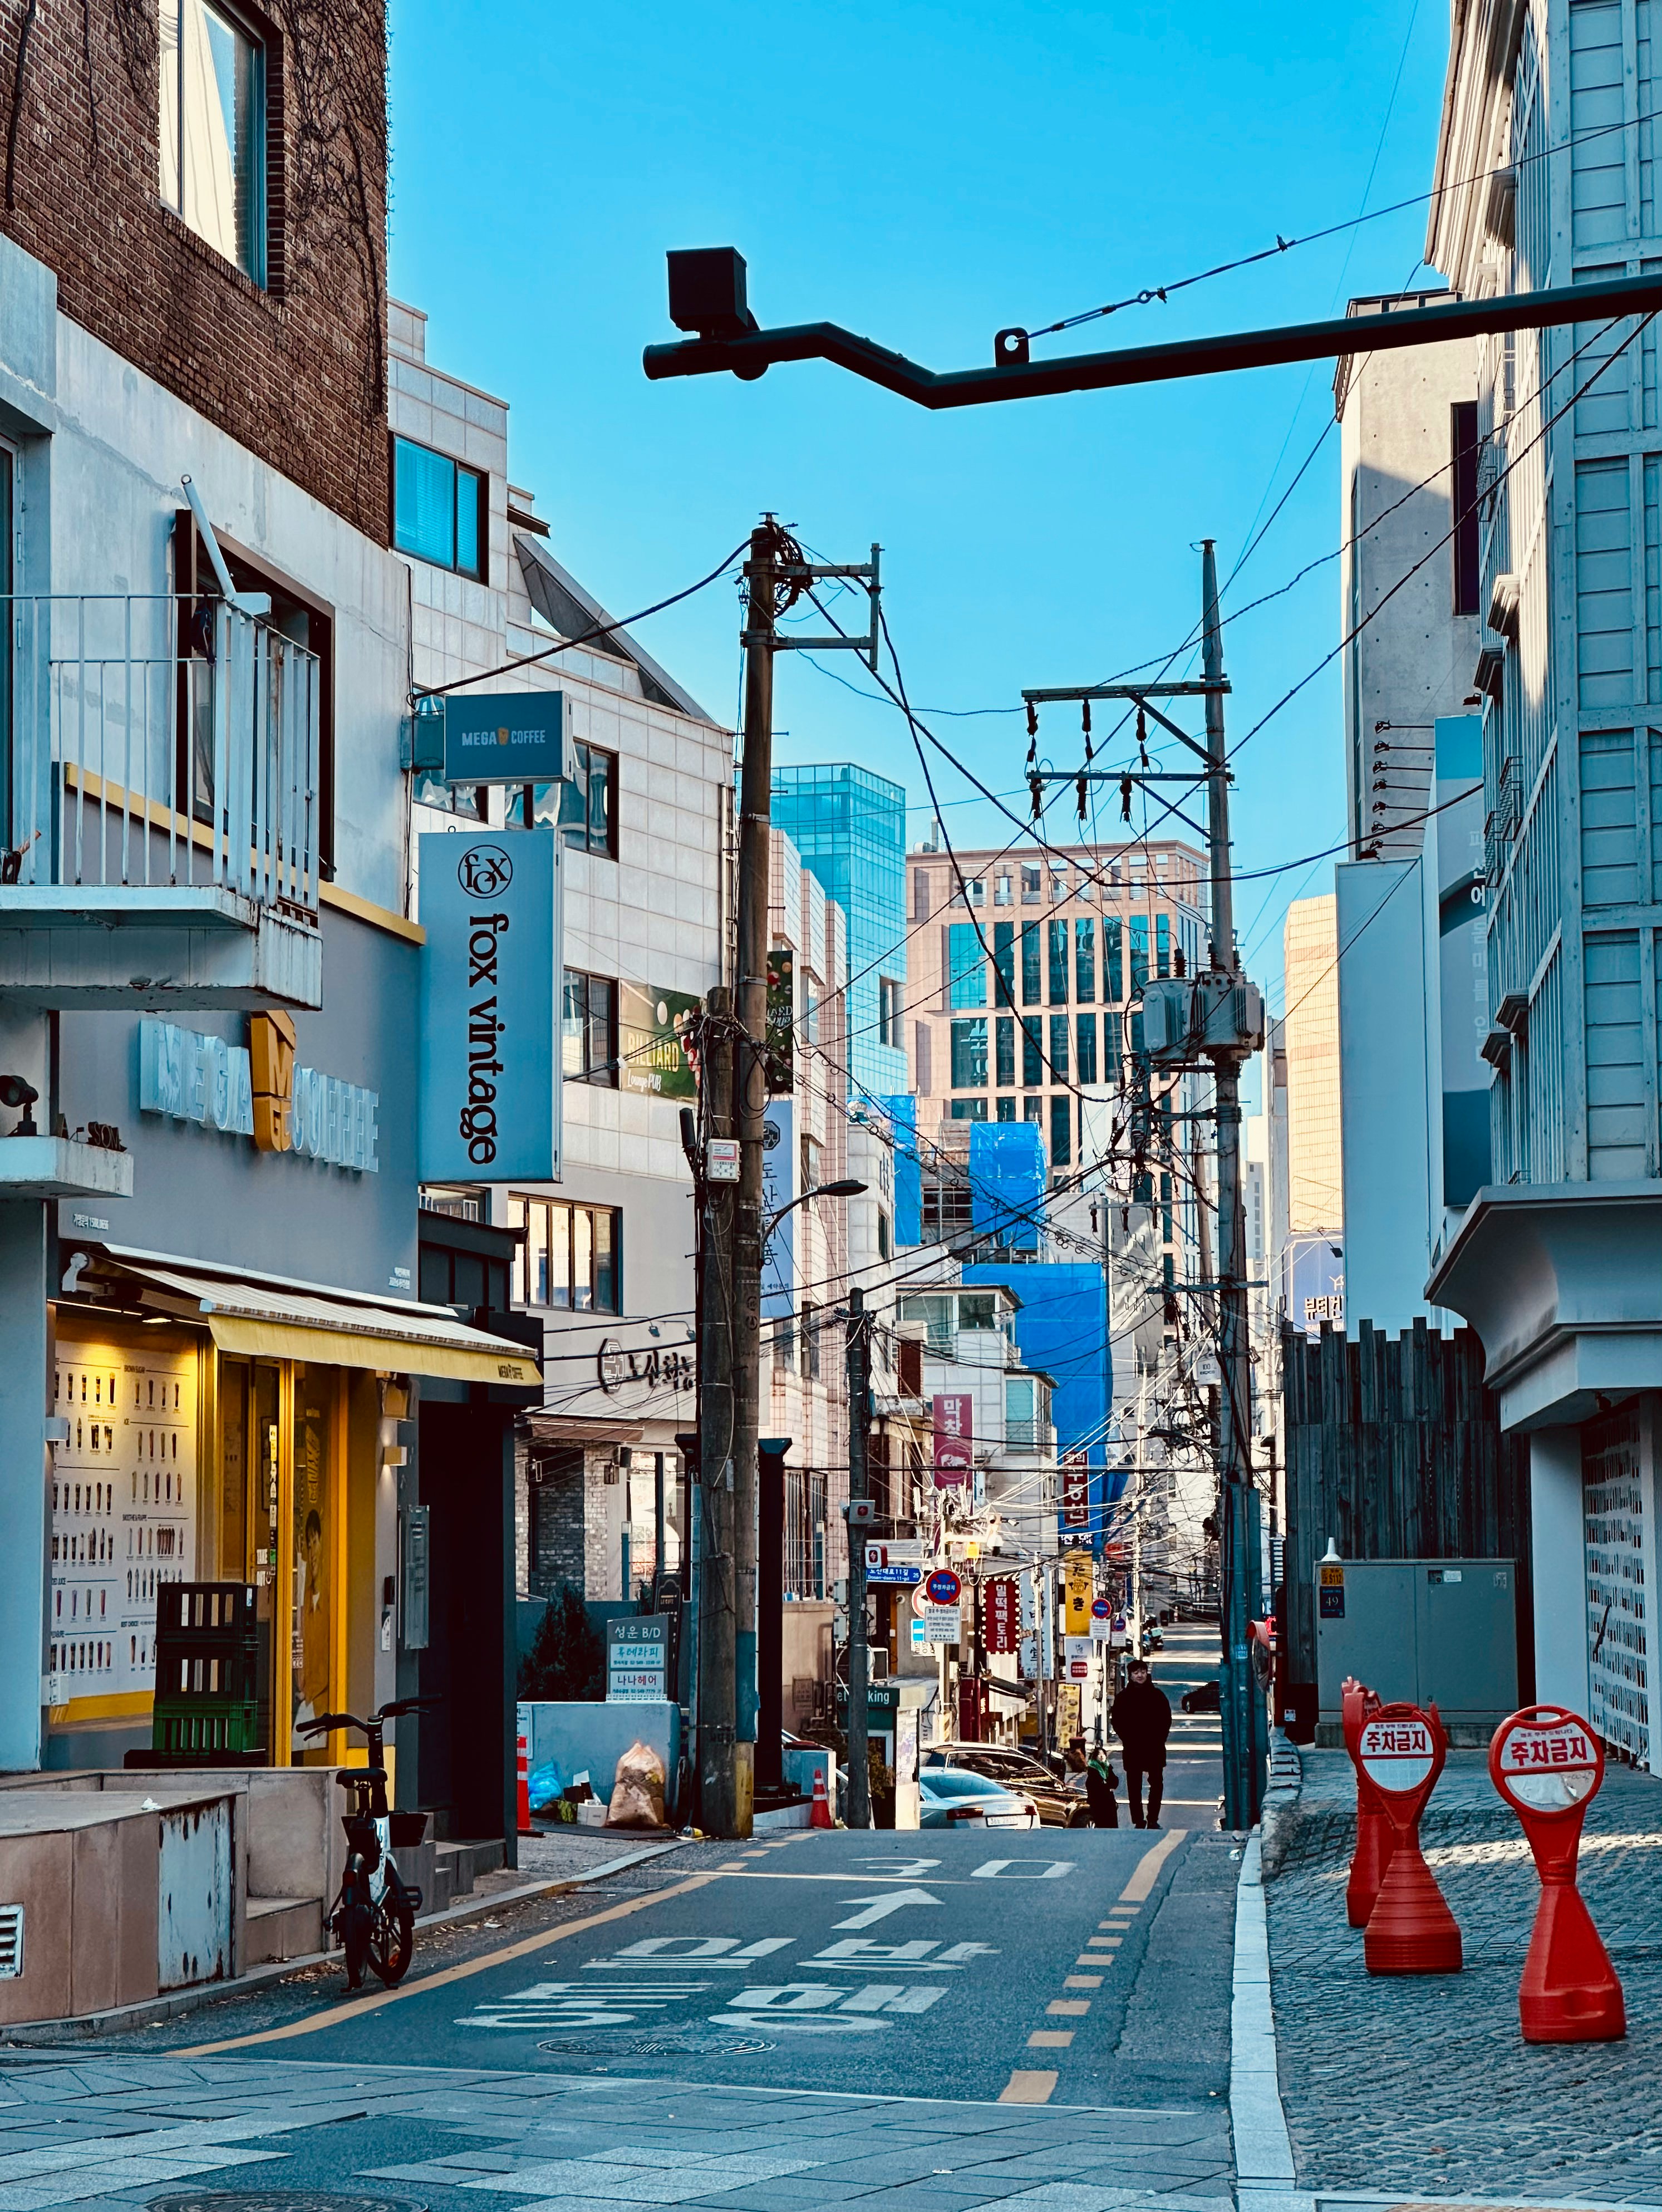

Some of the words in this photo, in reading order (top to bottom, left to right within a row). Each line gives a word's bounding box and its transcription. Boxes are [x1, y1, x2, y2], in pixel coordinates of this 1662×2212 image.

[462, 731, 496, 746] MEGA
[512, 730, 545, 744] COFFEE
[464, 853, 509, 894] fox
[469, 913, 509, 988] fox
[627, 1032, 680, 1073] BILLIARD
[140, 1019, 254, 1136] MEGA
[292, 1061, 378, 1172] COFFEE
[460, 996, 505, 1165] vintage
[627, 1069, 648, 1093] Lounge
[648, 1073, 662, 1092] PUB
[943, 1398, 963, 1440] 막창
[614, 1625, 638, 1639] 성운
[642, 1626, 661, 1639] B/D
[995, 1584, 1008, 1649] 밀떡팩토리
[617, 1675, 656, 1686] 나나헤어
[868, 1690, 889, 1704] king
[1367, 1729, 1426, 1752] 주차금지
[1511, 1736, 1587, 1767] 주차금지
[849, 1856, 1078, 1879] 30
[579, 1936, 1003, 1972] 일방
[453, 1982, 950, 2030] 통행
